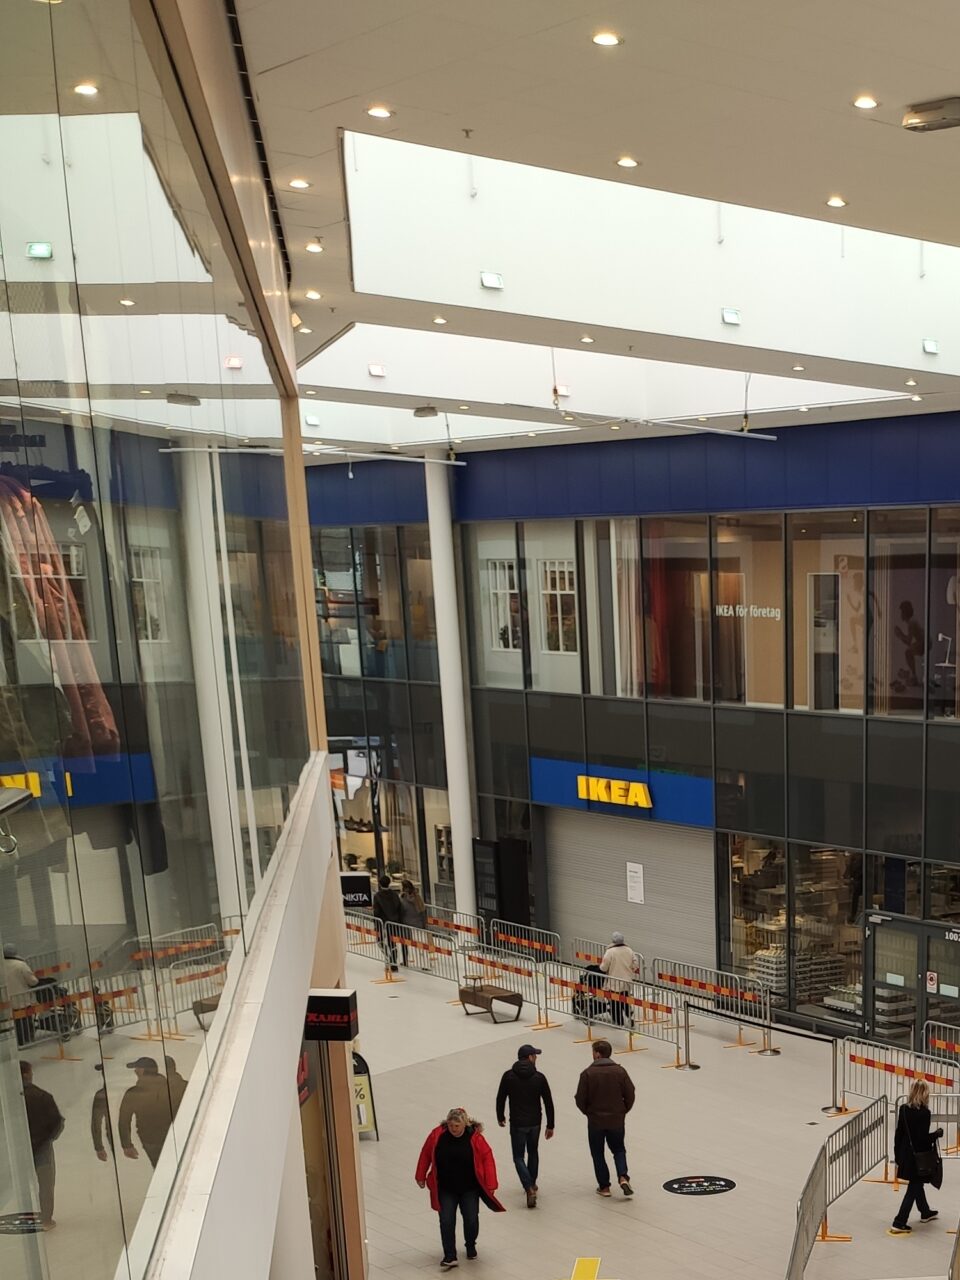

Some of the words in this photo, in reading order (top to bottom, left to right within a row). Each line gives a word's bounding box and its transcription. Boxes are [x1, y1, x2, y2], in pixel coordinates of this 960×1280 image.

[715, 604, 734, 617] IKEA
[736, 604, 748, 617] för
[750, 604, 781, 621] företag
[577, 775, 653, 808] IKEA
